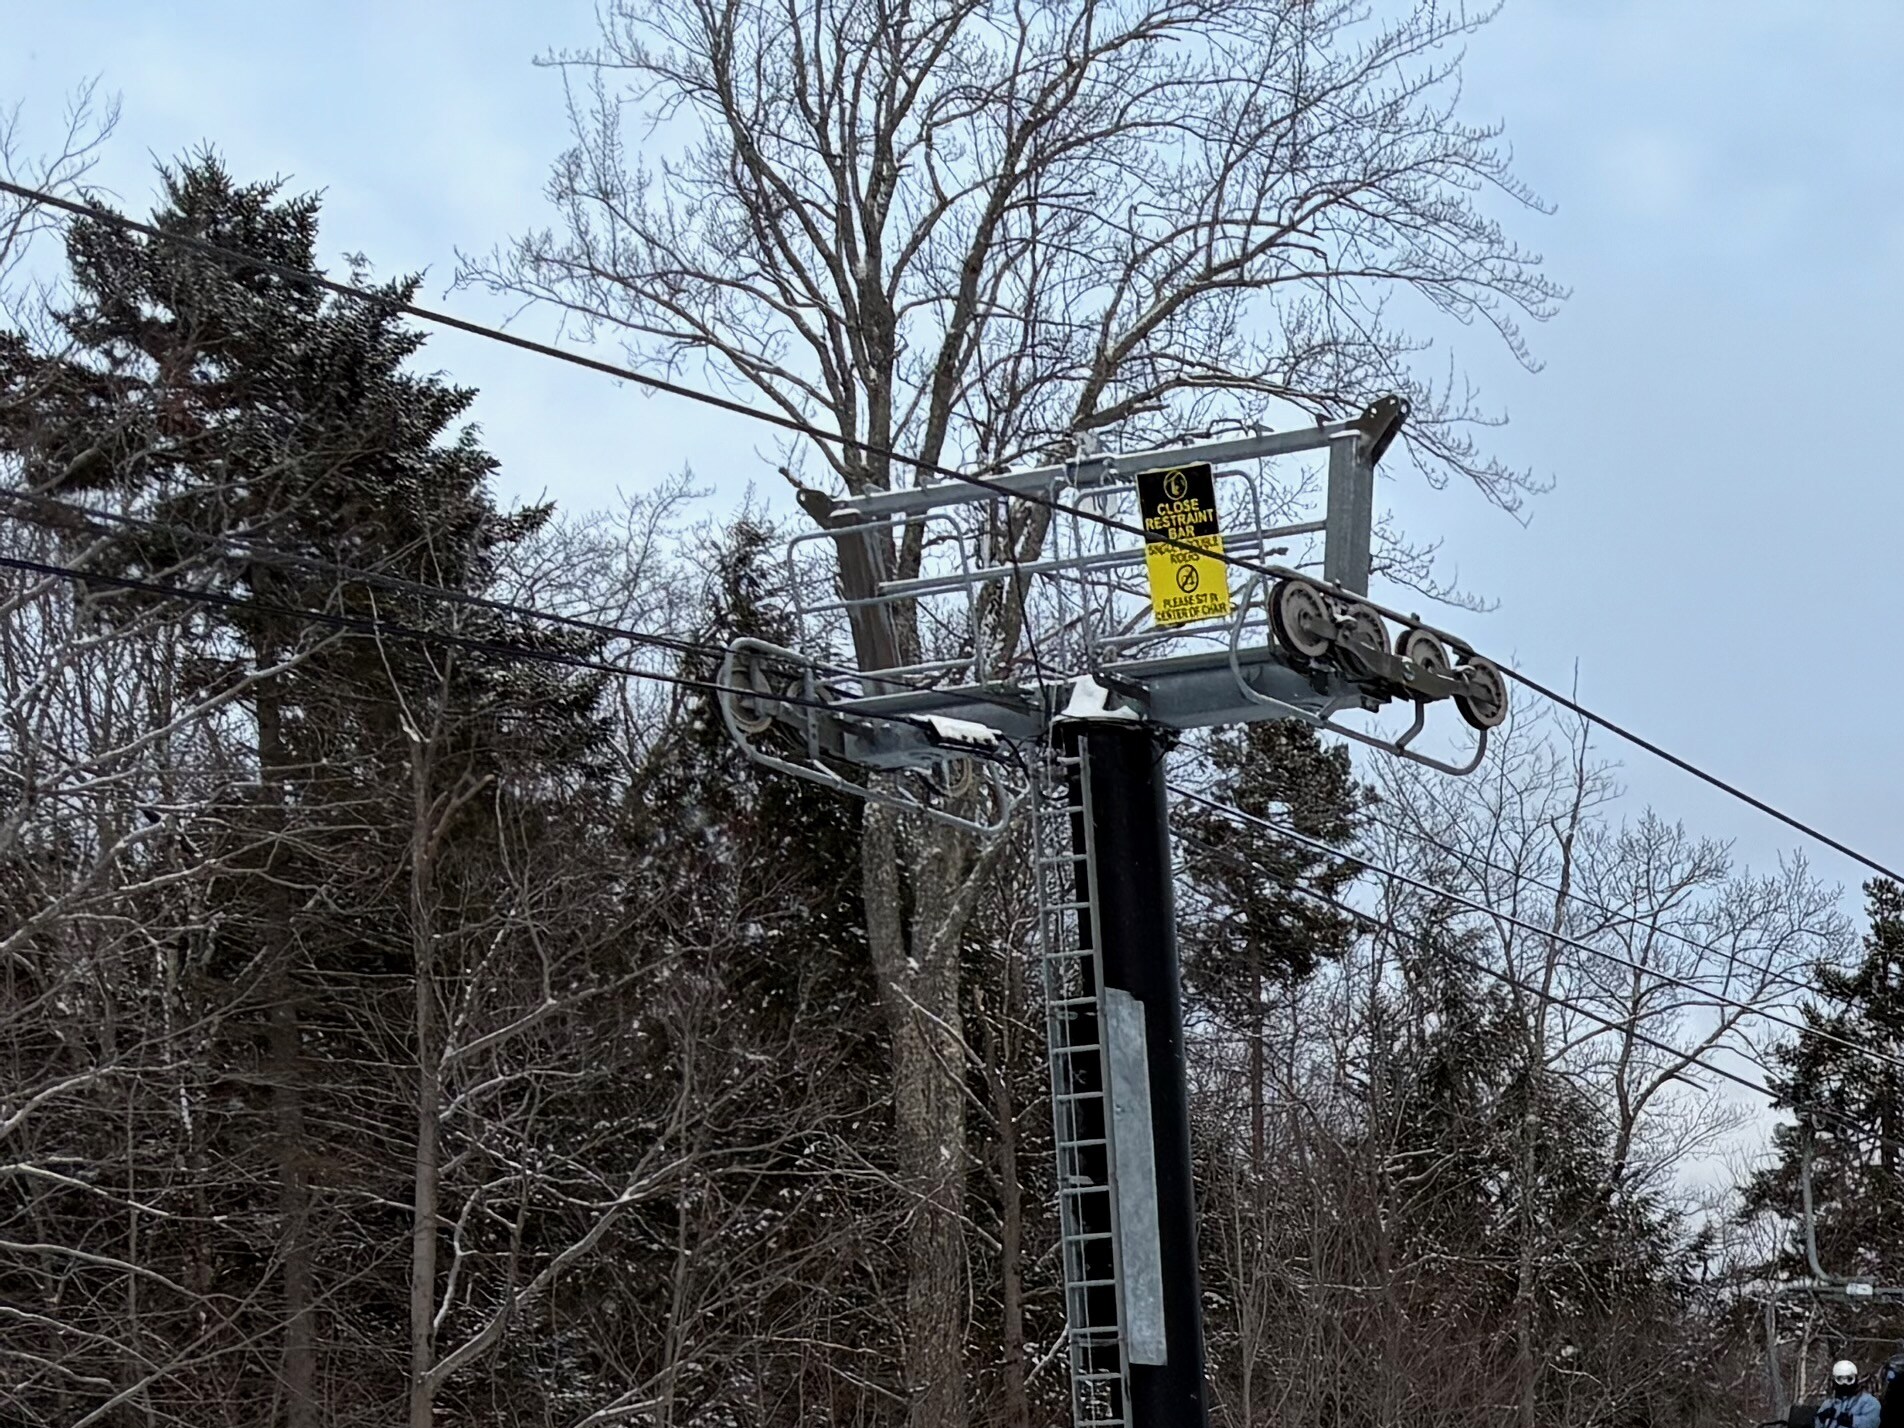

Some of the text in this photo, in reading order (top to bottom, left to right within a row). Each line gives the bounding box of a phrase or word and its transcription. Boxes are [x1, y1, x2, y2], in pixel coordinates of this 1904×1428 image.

[1157, 498, 1200, 516] CLOSE
[1145, 508, 1214, 531] RESTRAINT
[1168, 525, 1195, 540] BAR
